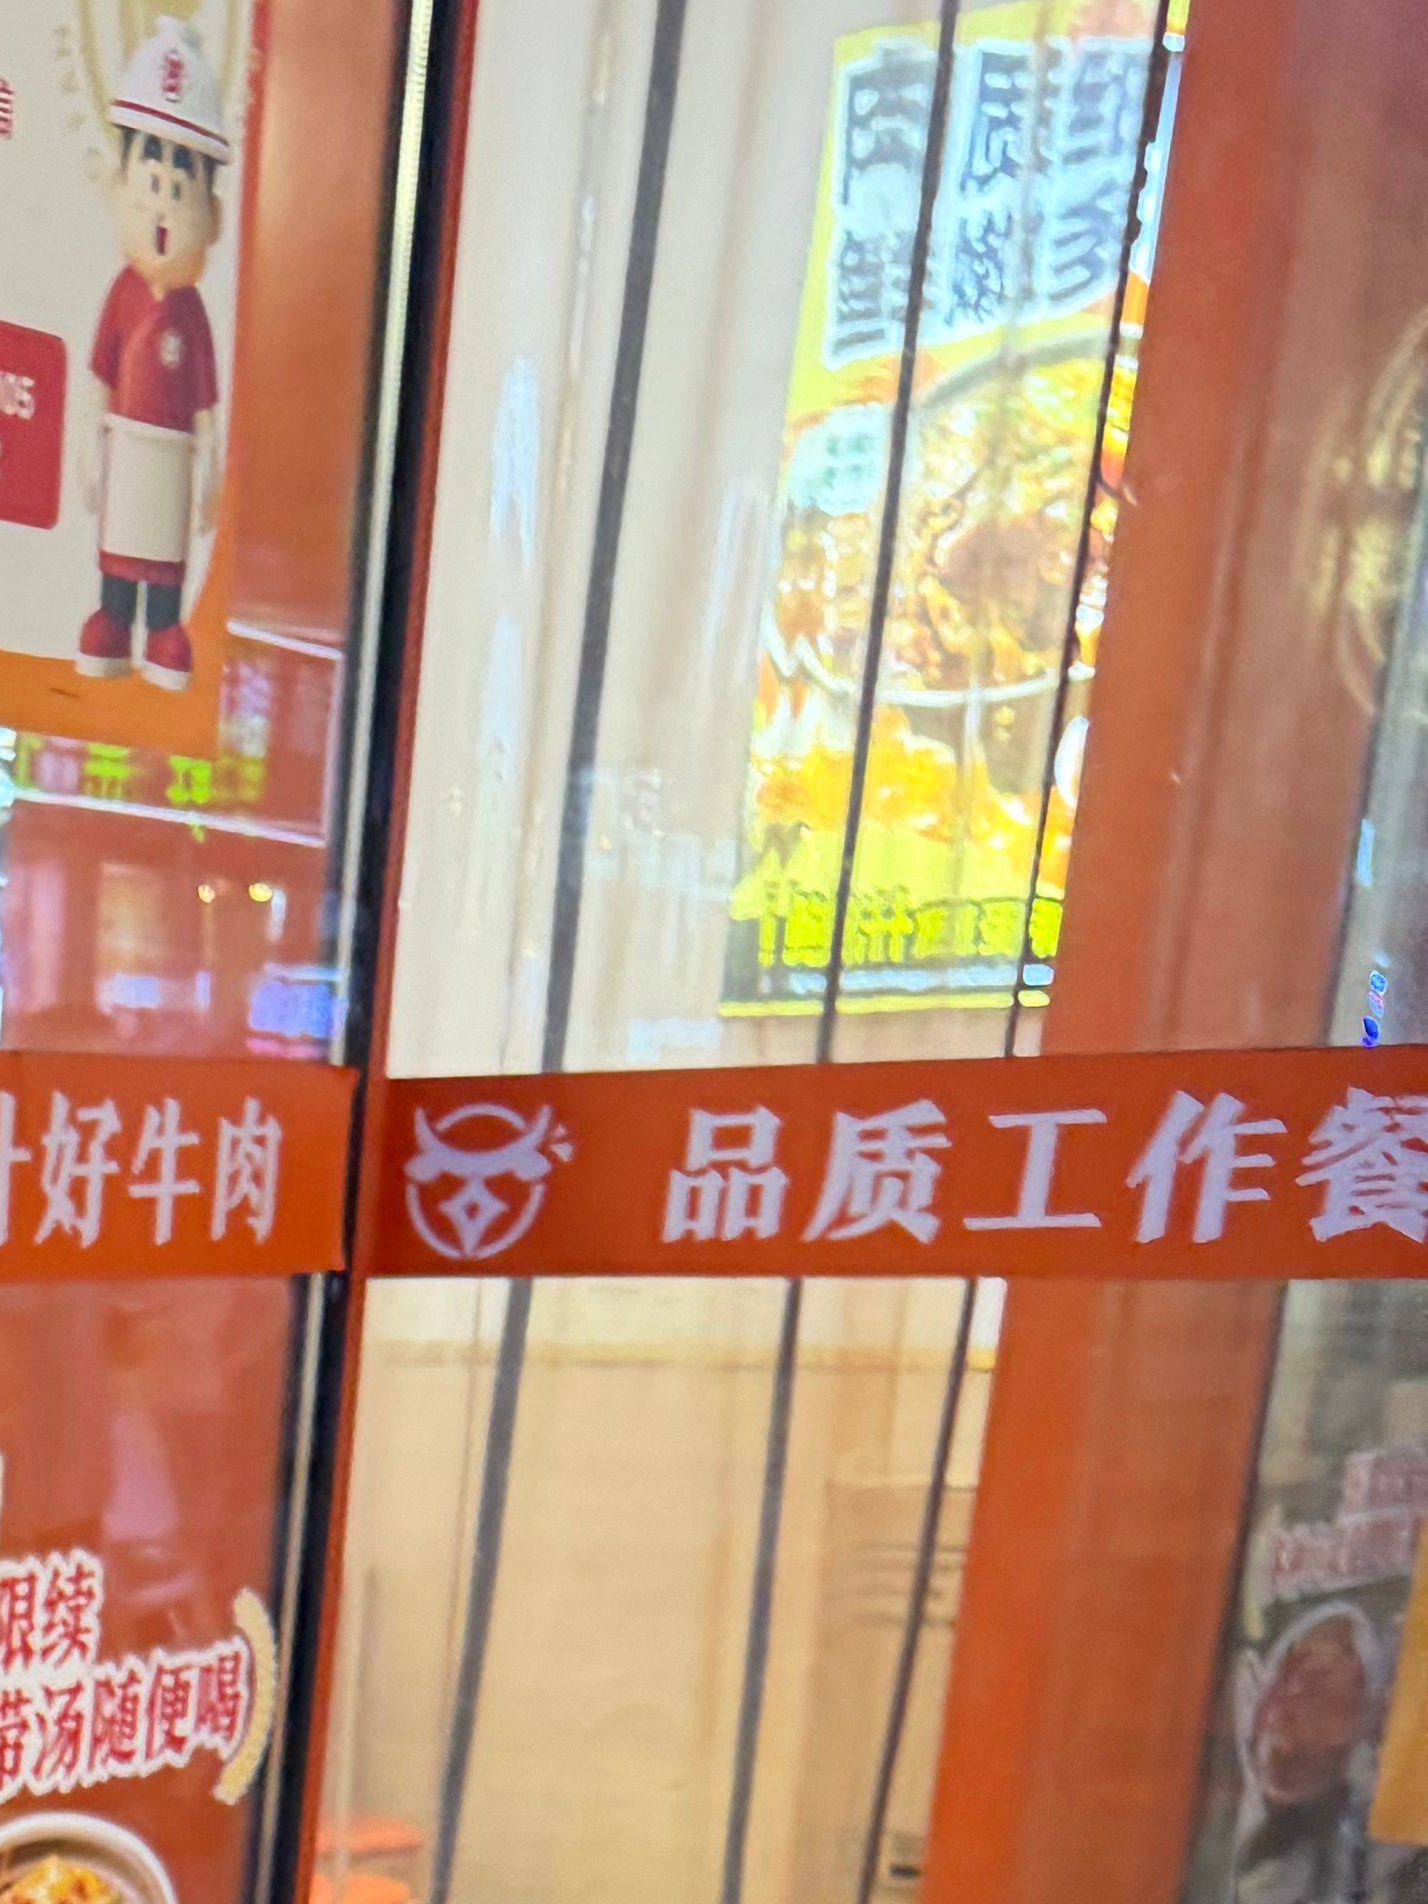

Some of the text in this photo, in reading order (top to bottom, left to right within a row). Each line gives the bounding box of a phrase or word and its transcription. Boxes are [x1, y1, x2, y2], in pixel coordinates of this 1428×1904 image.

[660, 1085, 1428, 1246] 品质工作餐
